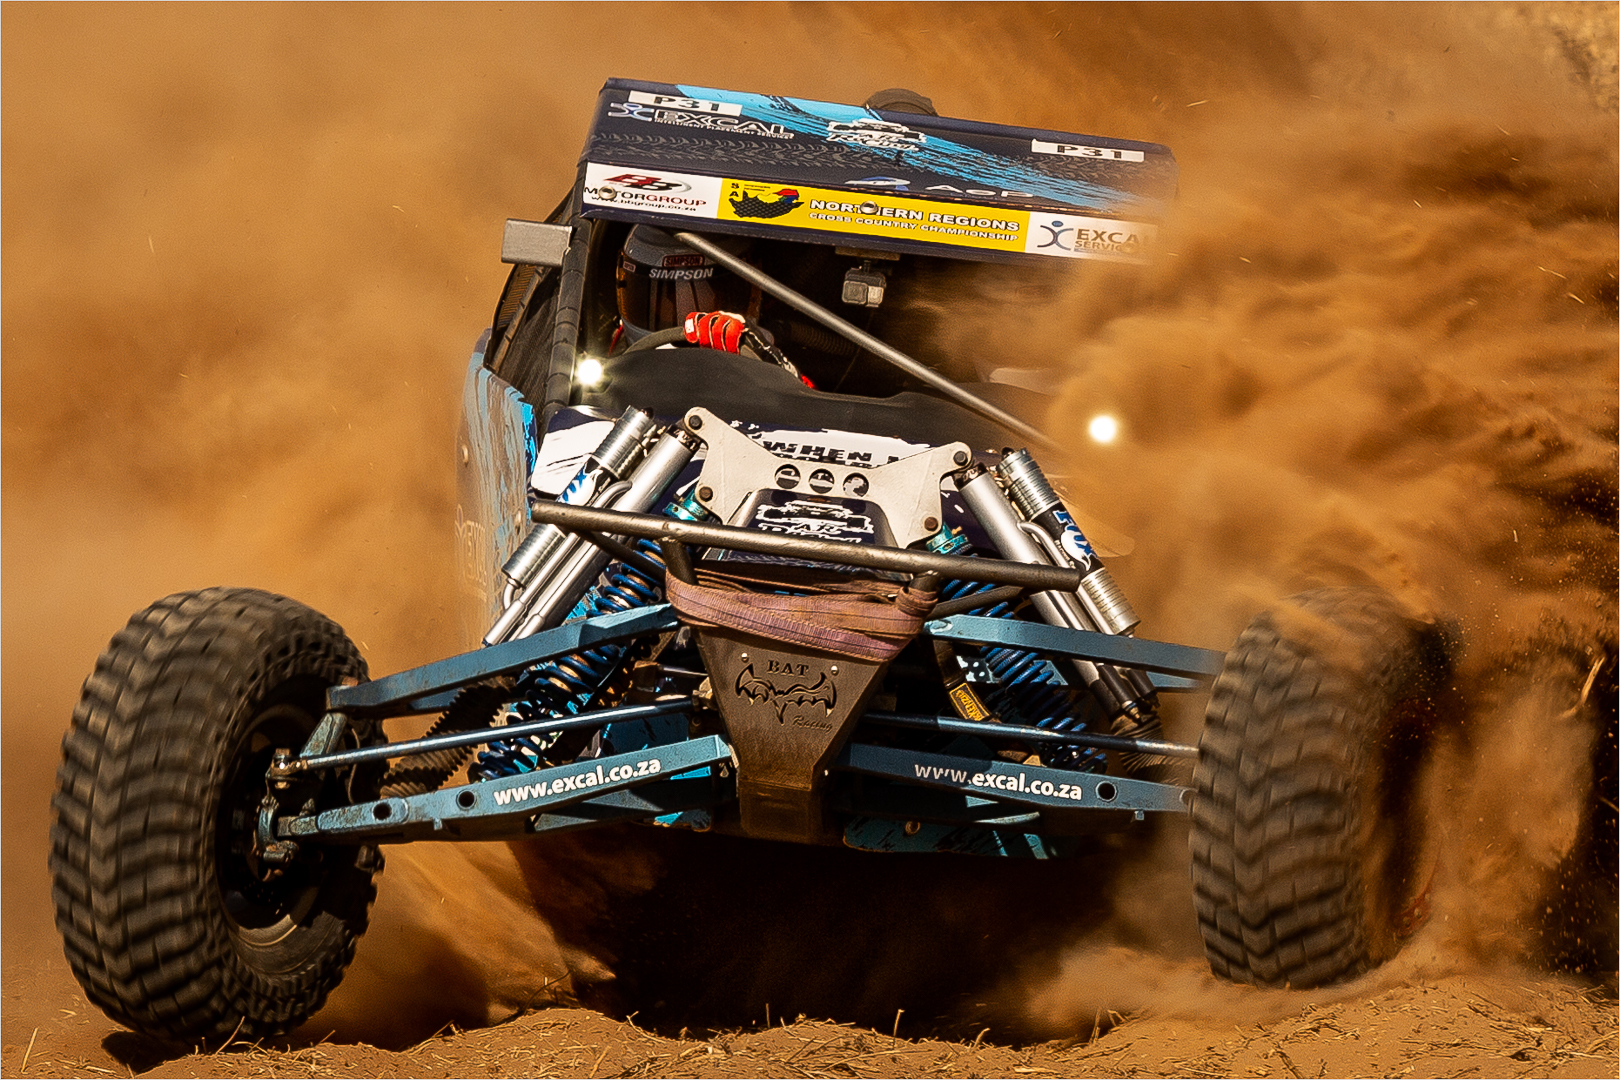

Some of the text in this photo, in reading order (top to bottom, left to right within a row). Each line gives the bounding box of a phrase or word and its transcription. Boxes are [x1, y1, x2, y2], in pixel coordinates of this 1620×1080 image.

[653, 96, 720, 112] P31
[655, 109, 795, 138] EXCAL
[1057, 144, 1122, 159] P31
[583, 186, 707, 207] MTORGROUP
[808, 212, 1019, 242] CROSS COUNTRY CHAMPIONSHIP
[928, 212, 1020, 232] REGIONS
[1076, 228, 1148, 245] EXCA
[649, 267, 714, 280] SIMPSON
[763, 440, 873, 462] WHEN
[766, 659, 810, 678] BAT
[792, 714, 833, 735] Racing
[493, 758, 662, 806] www.excal.co.za
[914, 763, 1083, 801] www.excal.co.za
